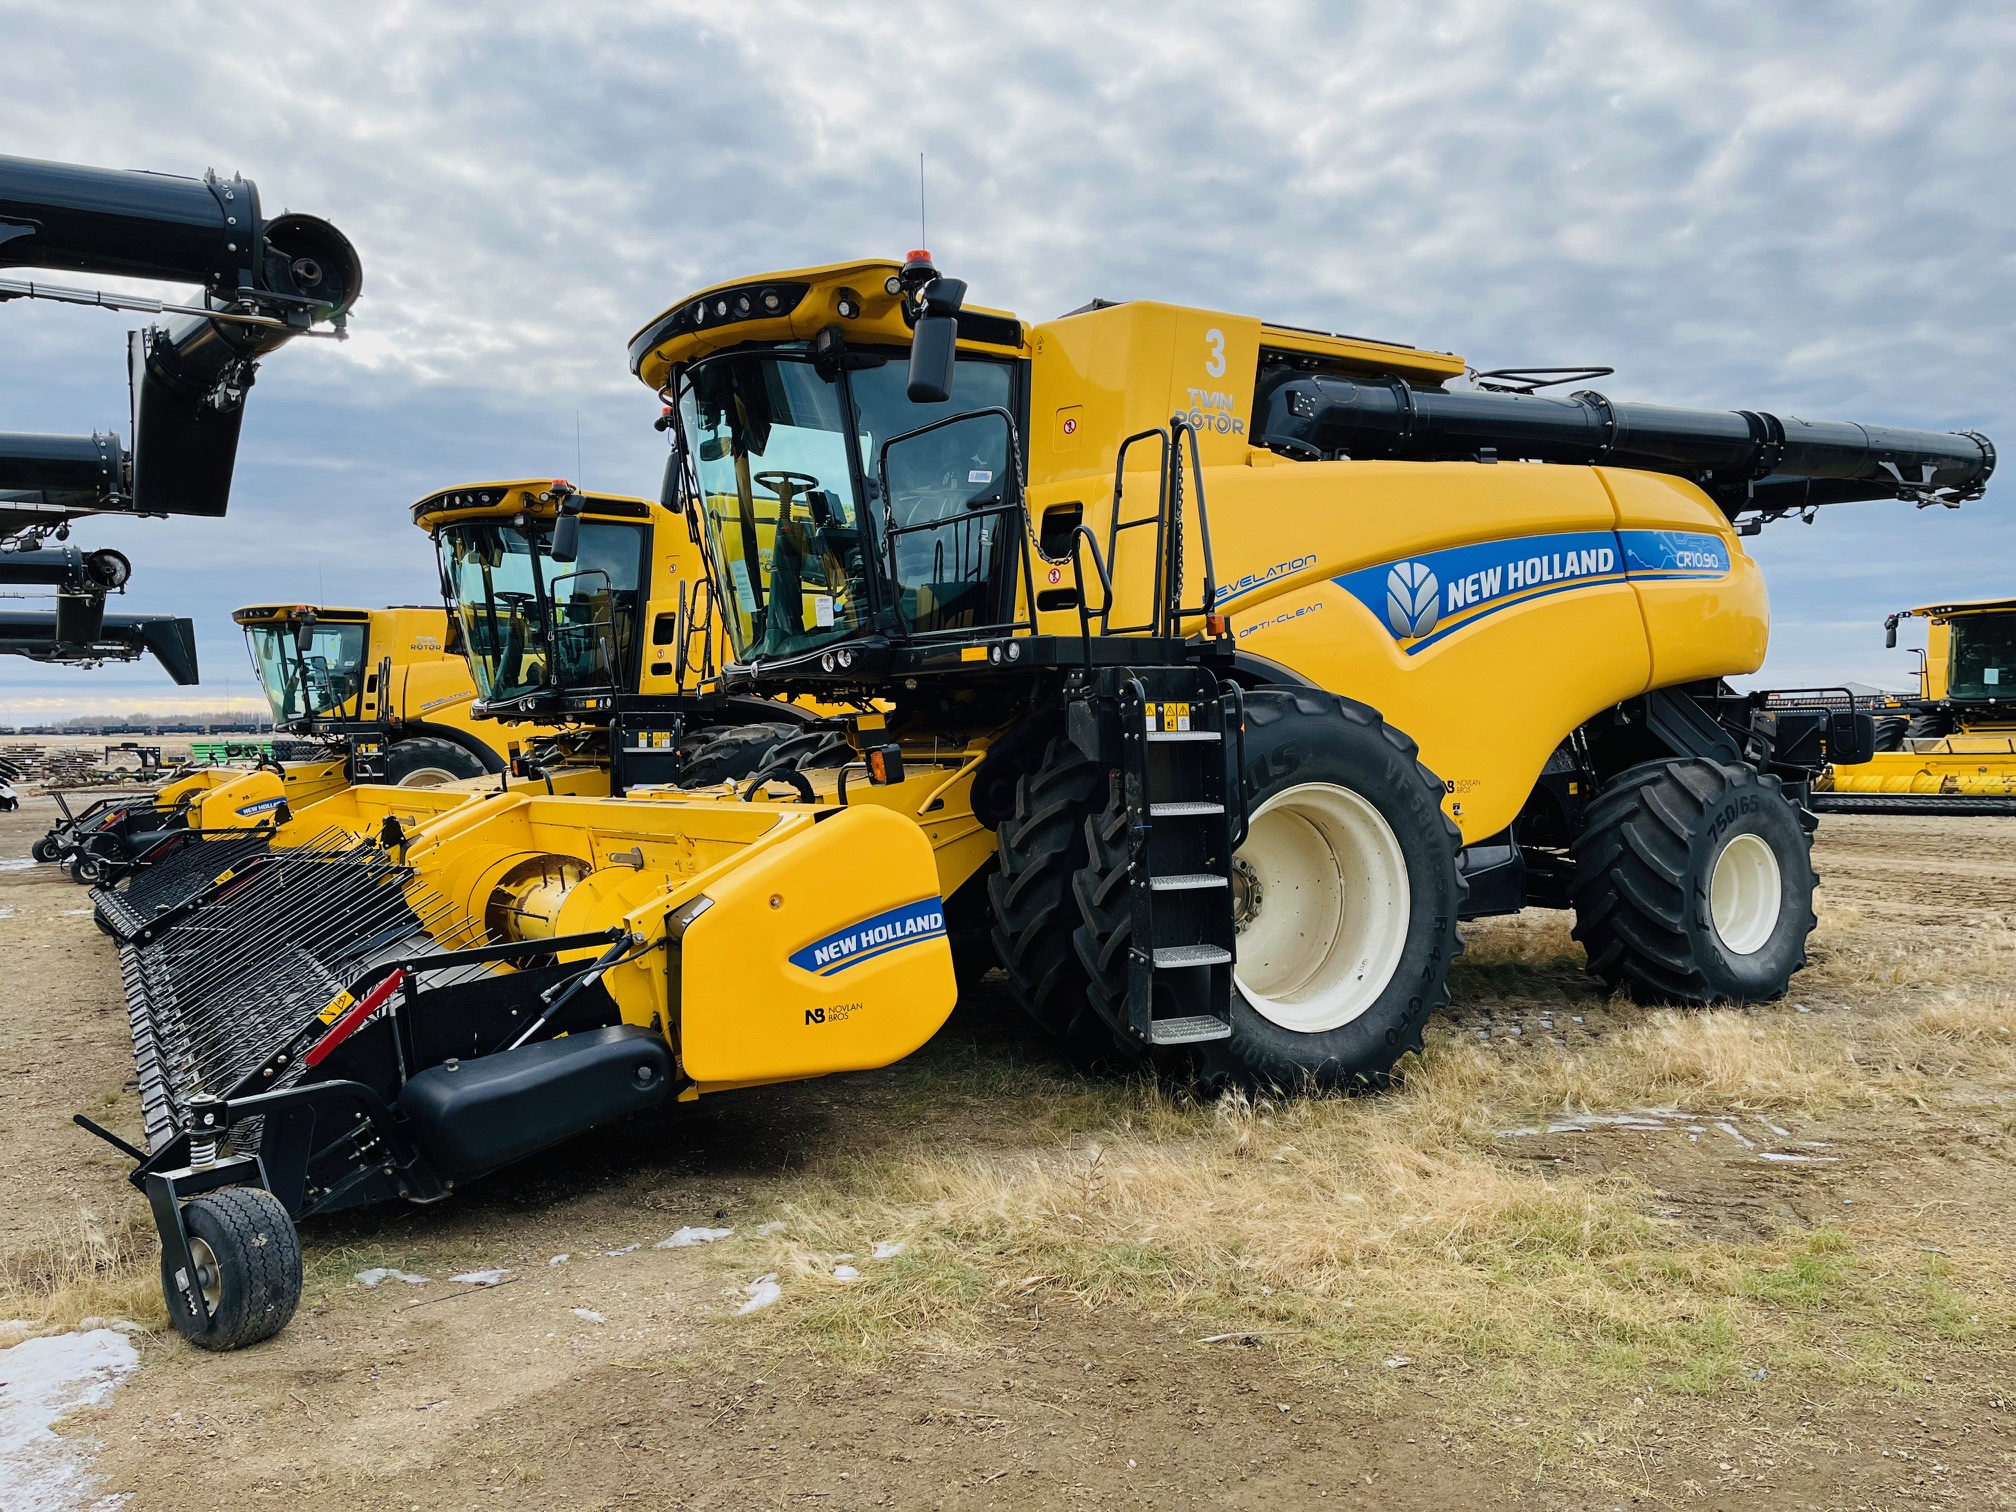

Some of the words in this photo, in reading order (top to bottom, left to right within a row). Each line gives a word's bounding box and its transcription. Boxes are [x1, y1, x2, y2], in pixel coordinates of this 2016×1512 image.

[1205, 328, 1226, 378] 3
[1186, 387, 1234, 411] TWIN
[1213, 554, 1317, 598] EVELATION
[1448, 565, 1502, 612] NEW
[1508, 548, 1615, 591] HOLLAND
[1239, 602, 1323, 638] OPTI-CLEAN
[411, 643, 442, 651] ROTOR
[243, 805, 258, 815] NEW
[814, 935, 857, 966] NEW
[860, 912, 943, 948] HOLLAND
[805, 1008, 826, 1026] NB
[828, 1003, 863, 1014] NOVLAN
[828, 1012, 850, 1023] BROS
